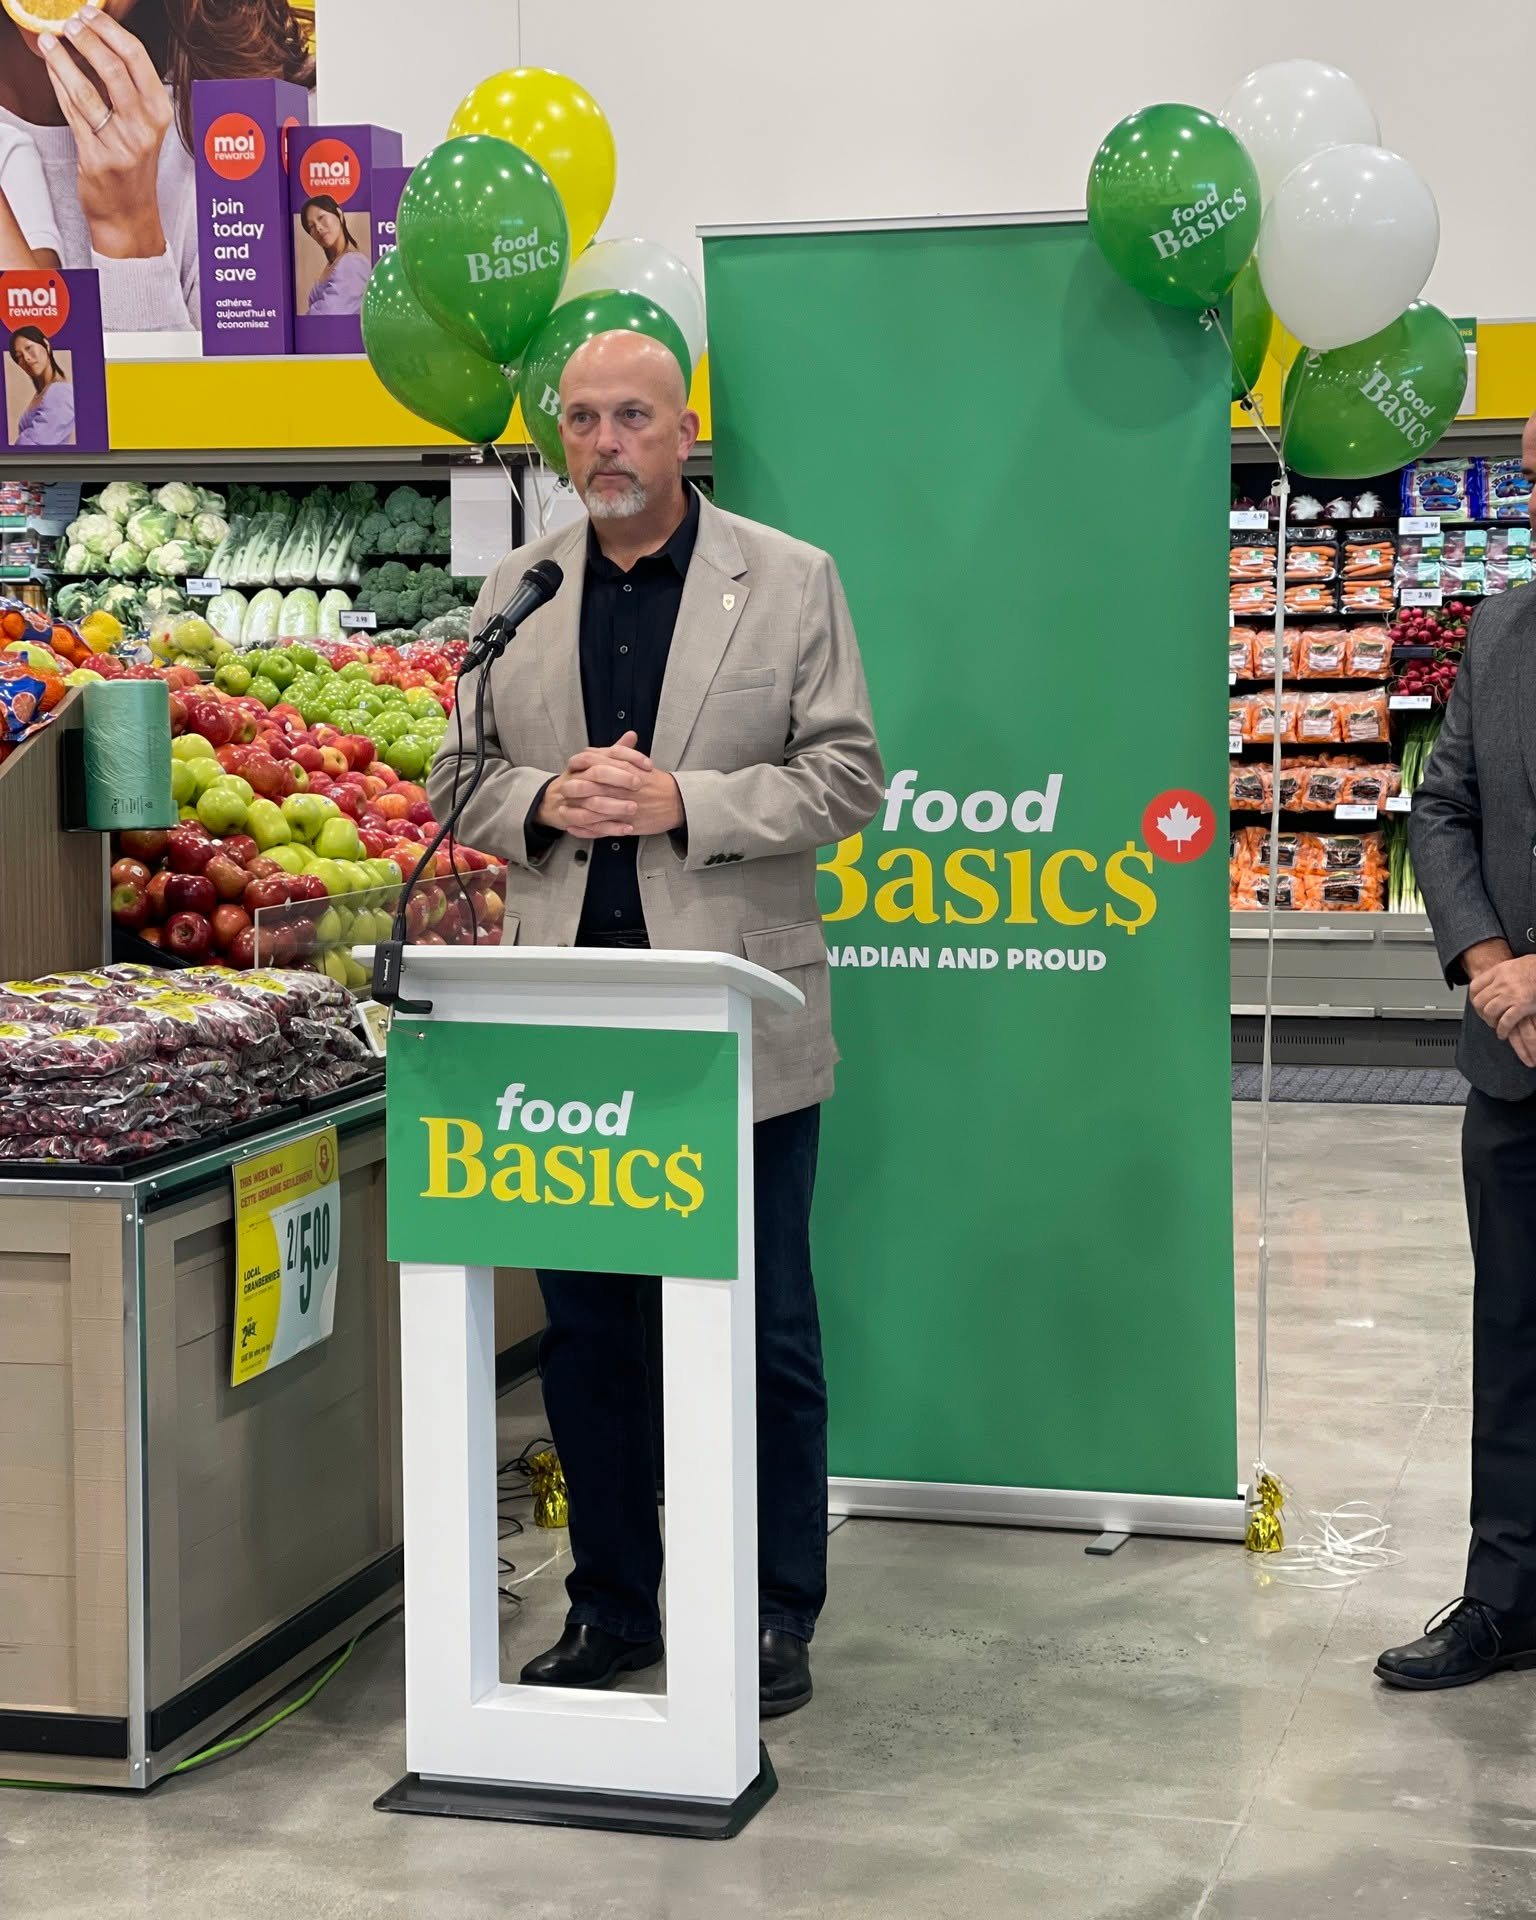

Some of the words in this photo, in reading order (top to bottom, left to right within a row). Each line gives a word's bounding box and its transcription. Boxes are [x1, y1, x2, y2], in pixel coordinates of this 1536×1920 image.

[214, 129, 255, 152] moi
[215, 151, 255, 161] rewards
[309, 155, 350, 177] moi
[310, 176, 350, 187] rewards
[211, 197, 244, 218] join
[1172, 185, 1219, 227] food
[213, 220, 265, 240] today
[378, 221, 396, 234] re
[492, 226, 538, 255] food
[214, 243, 249, 259] and
[215, 267, 257, 282] save
[7, 279, 57, 307] moi
[215, 298, 252, 307] adhérez
[8, 305, 58, 317] rewards
[216, 308, 266, 319] aujourd'hui
[266, 309, 277, 317] et
[216, 320, 270, 329] économisez
[1396, 379, 1436, 418] food
[882, 769, 1063, 833] food
[825, 945, 929, 968] NADIAN
[937, 947, 999, 970] AND
[1007, 947, 1107, 971] PROUD
[495, 1082, 634, 1136] food
[240, 1175, 252, 1190] THIS
[253, 1169, 269, 1184] WEEK
[269, 1163, 283, 1177] ONLY
[240, 1193, 257, 1209] CETTE
[243, 1266, 261, 1281] LOCAL
[244, 1269, 281, 1295] CRANBERRIES
